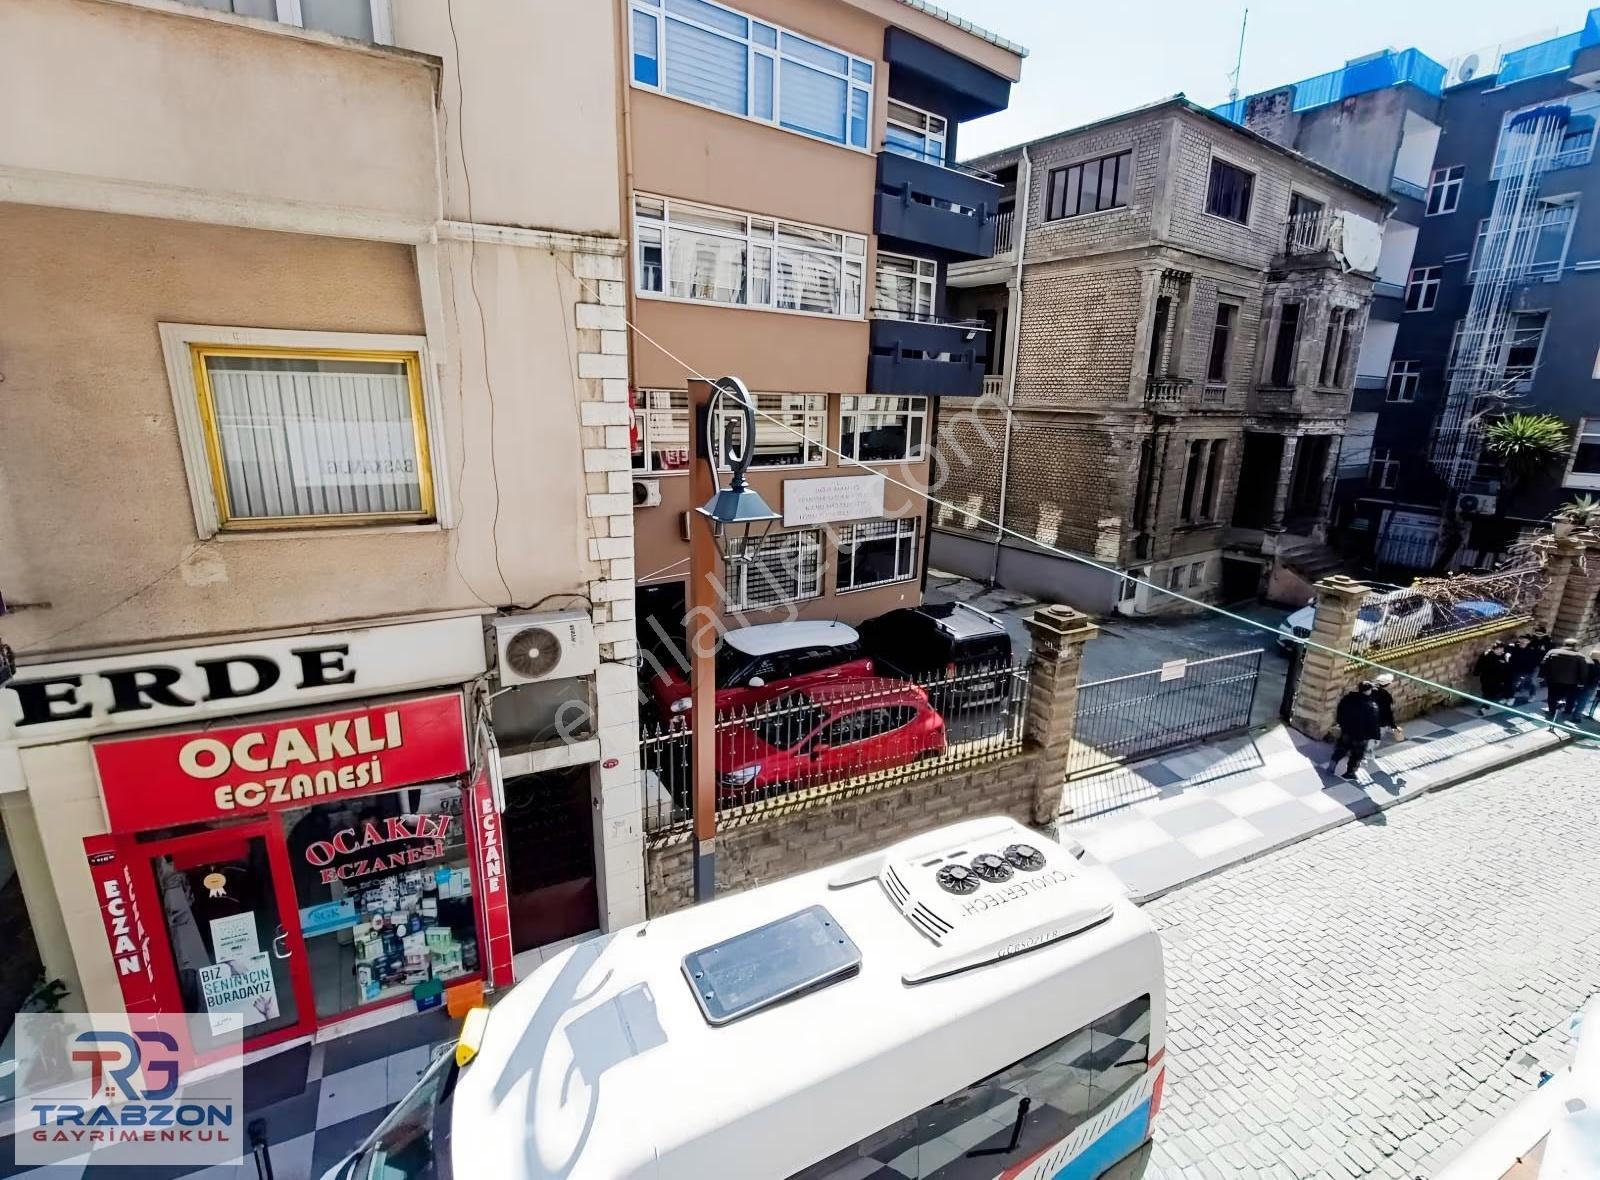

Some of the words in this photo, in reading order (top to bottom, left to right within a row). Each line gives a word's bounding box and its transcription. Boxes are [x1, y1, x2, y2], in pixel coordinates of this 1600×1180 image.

[4, 644, 356, 727] ERDE
[178, 710, 403, 779] OCAKLI
[214, 756, 383, 809] ECZANESİ
[305, 815, 453, 866] OCAKLI
[482, 798, 500, 893] ECZANE
[207, 981, 271, 1007] BURADAYIZ
